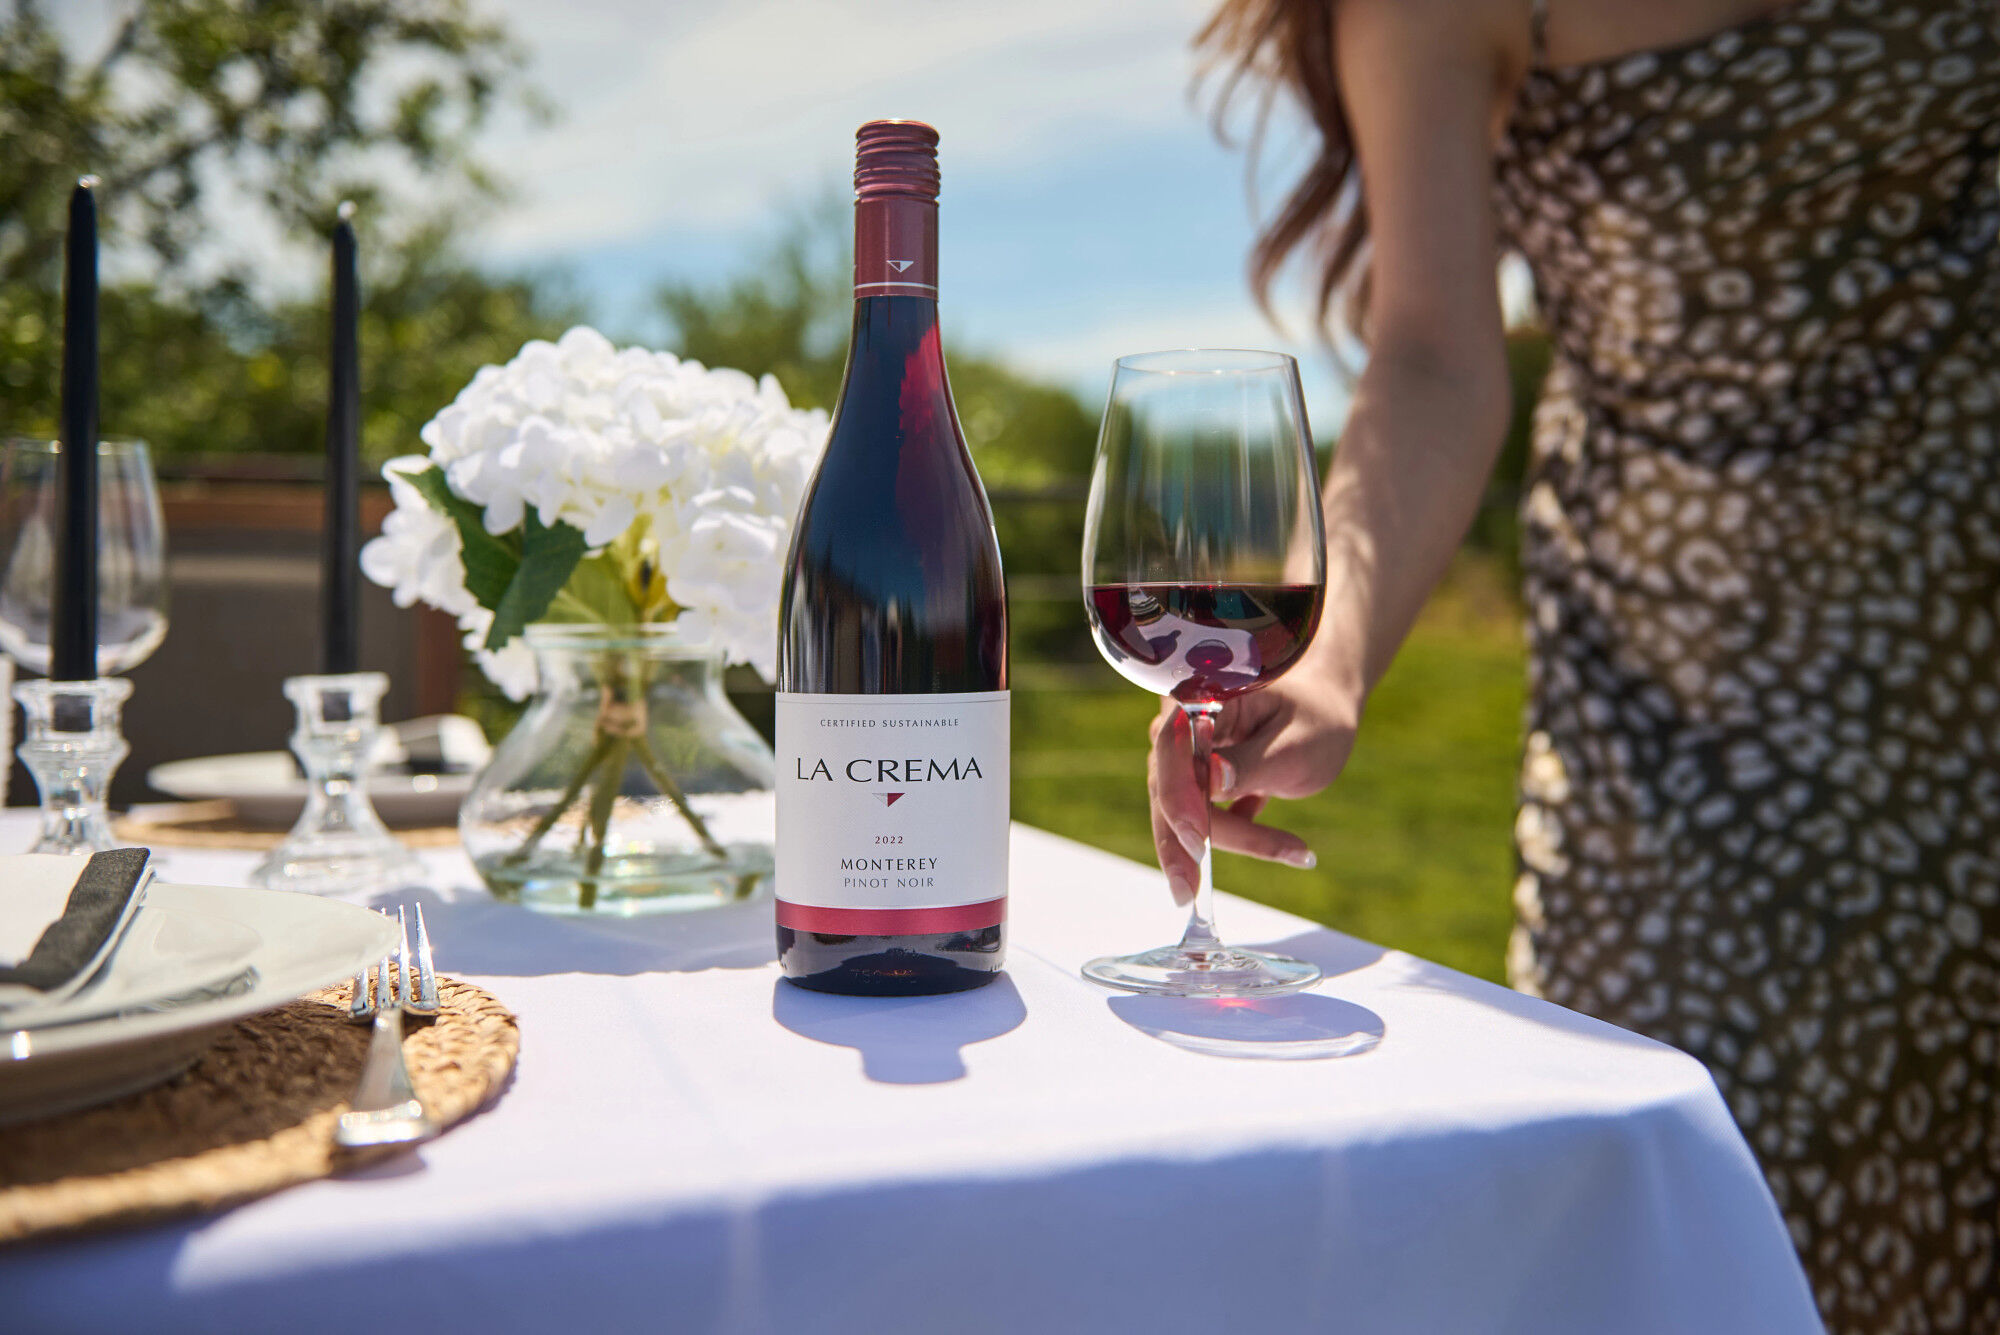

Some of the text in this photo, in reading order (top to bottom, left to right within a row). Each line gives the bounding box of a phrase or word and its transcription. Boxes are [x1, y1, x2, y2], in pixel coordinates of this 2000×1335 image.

[820, 718, 959, 728] CERTIFIED SUSTAINABLE
[797, 757, 983, 783] LA CREMA
[875, 835, 904, 845] 2022
[840, 857, 938, 871] MONTEREY
[844, 877, 934, 889] PINOT NOIR
